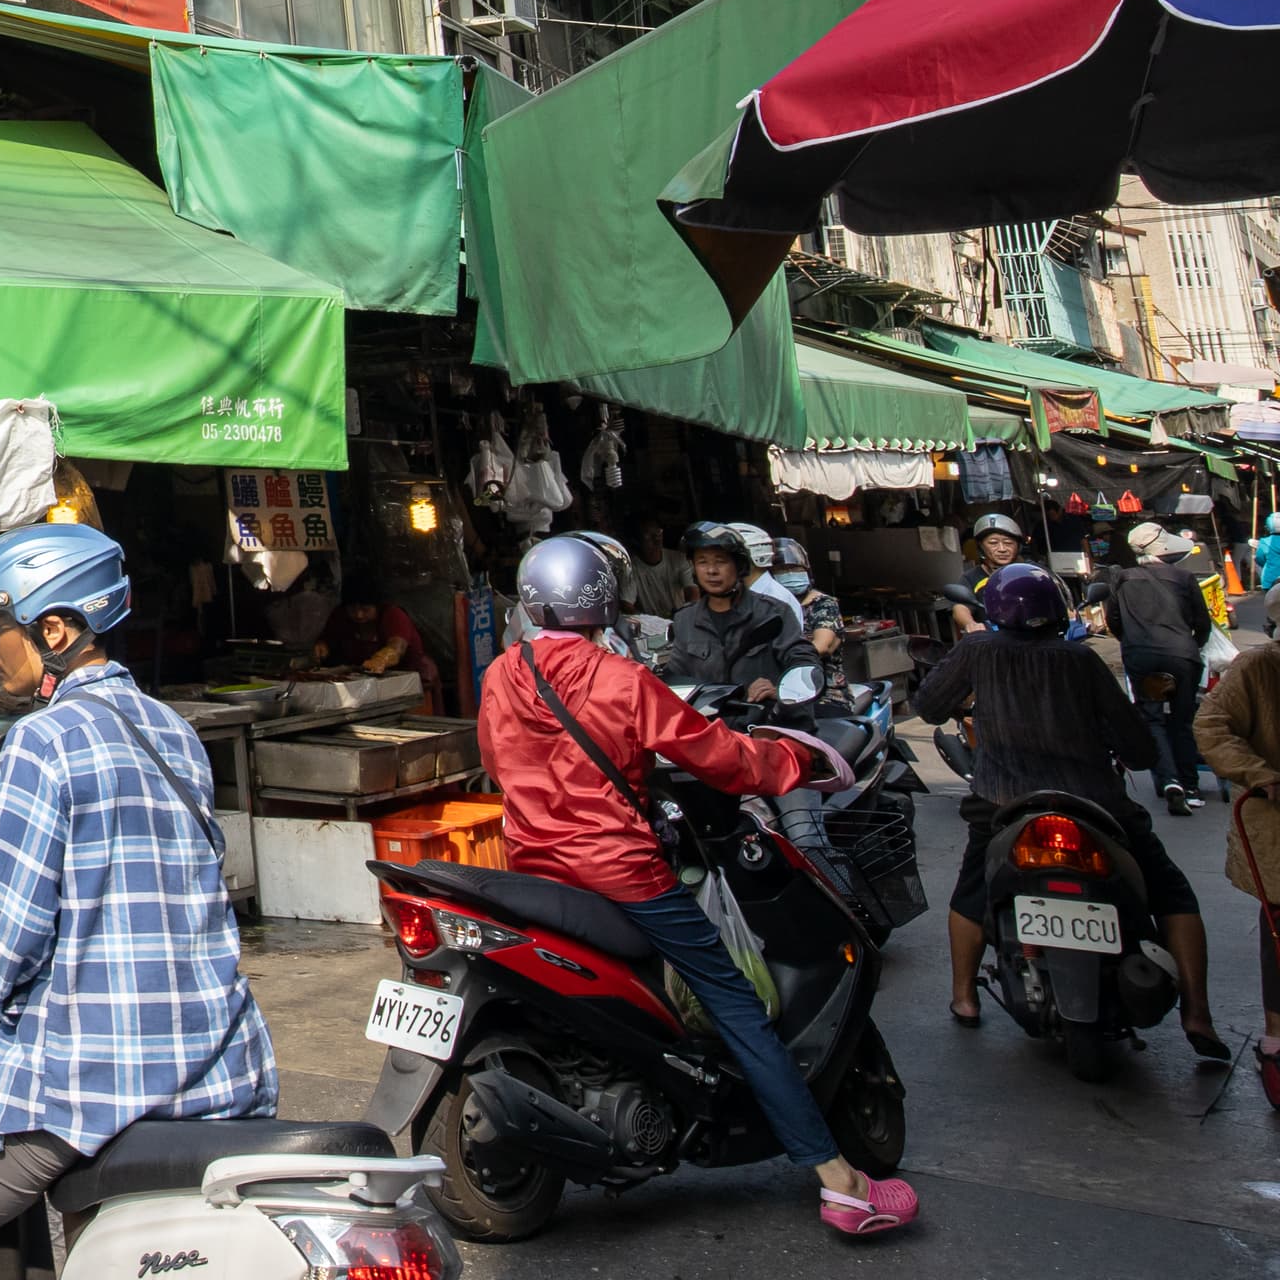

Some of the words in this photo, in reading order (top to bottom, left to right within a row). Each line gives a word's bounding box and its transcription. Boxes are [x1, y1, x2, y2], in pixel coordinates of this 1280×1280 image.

[200, 395, 285, 420] 佳典帆布行
[202, 422, 282, 443] 05-2300478
[1020, 912, 1064, 938] 230
[1071, 918, 1117, 944] CCU
[138, 1249, 209, 1279] Nice
